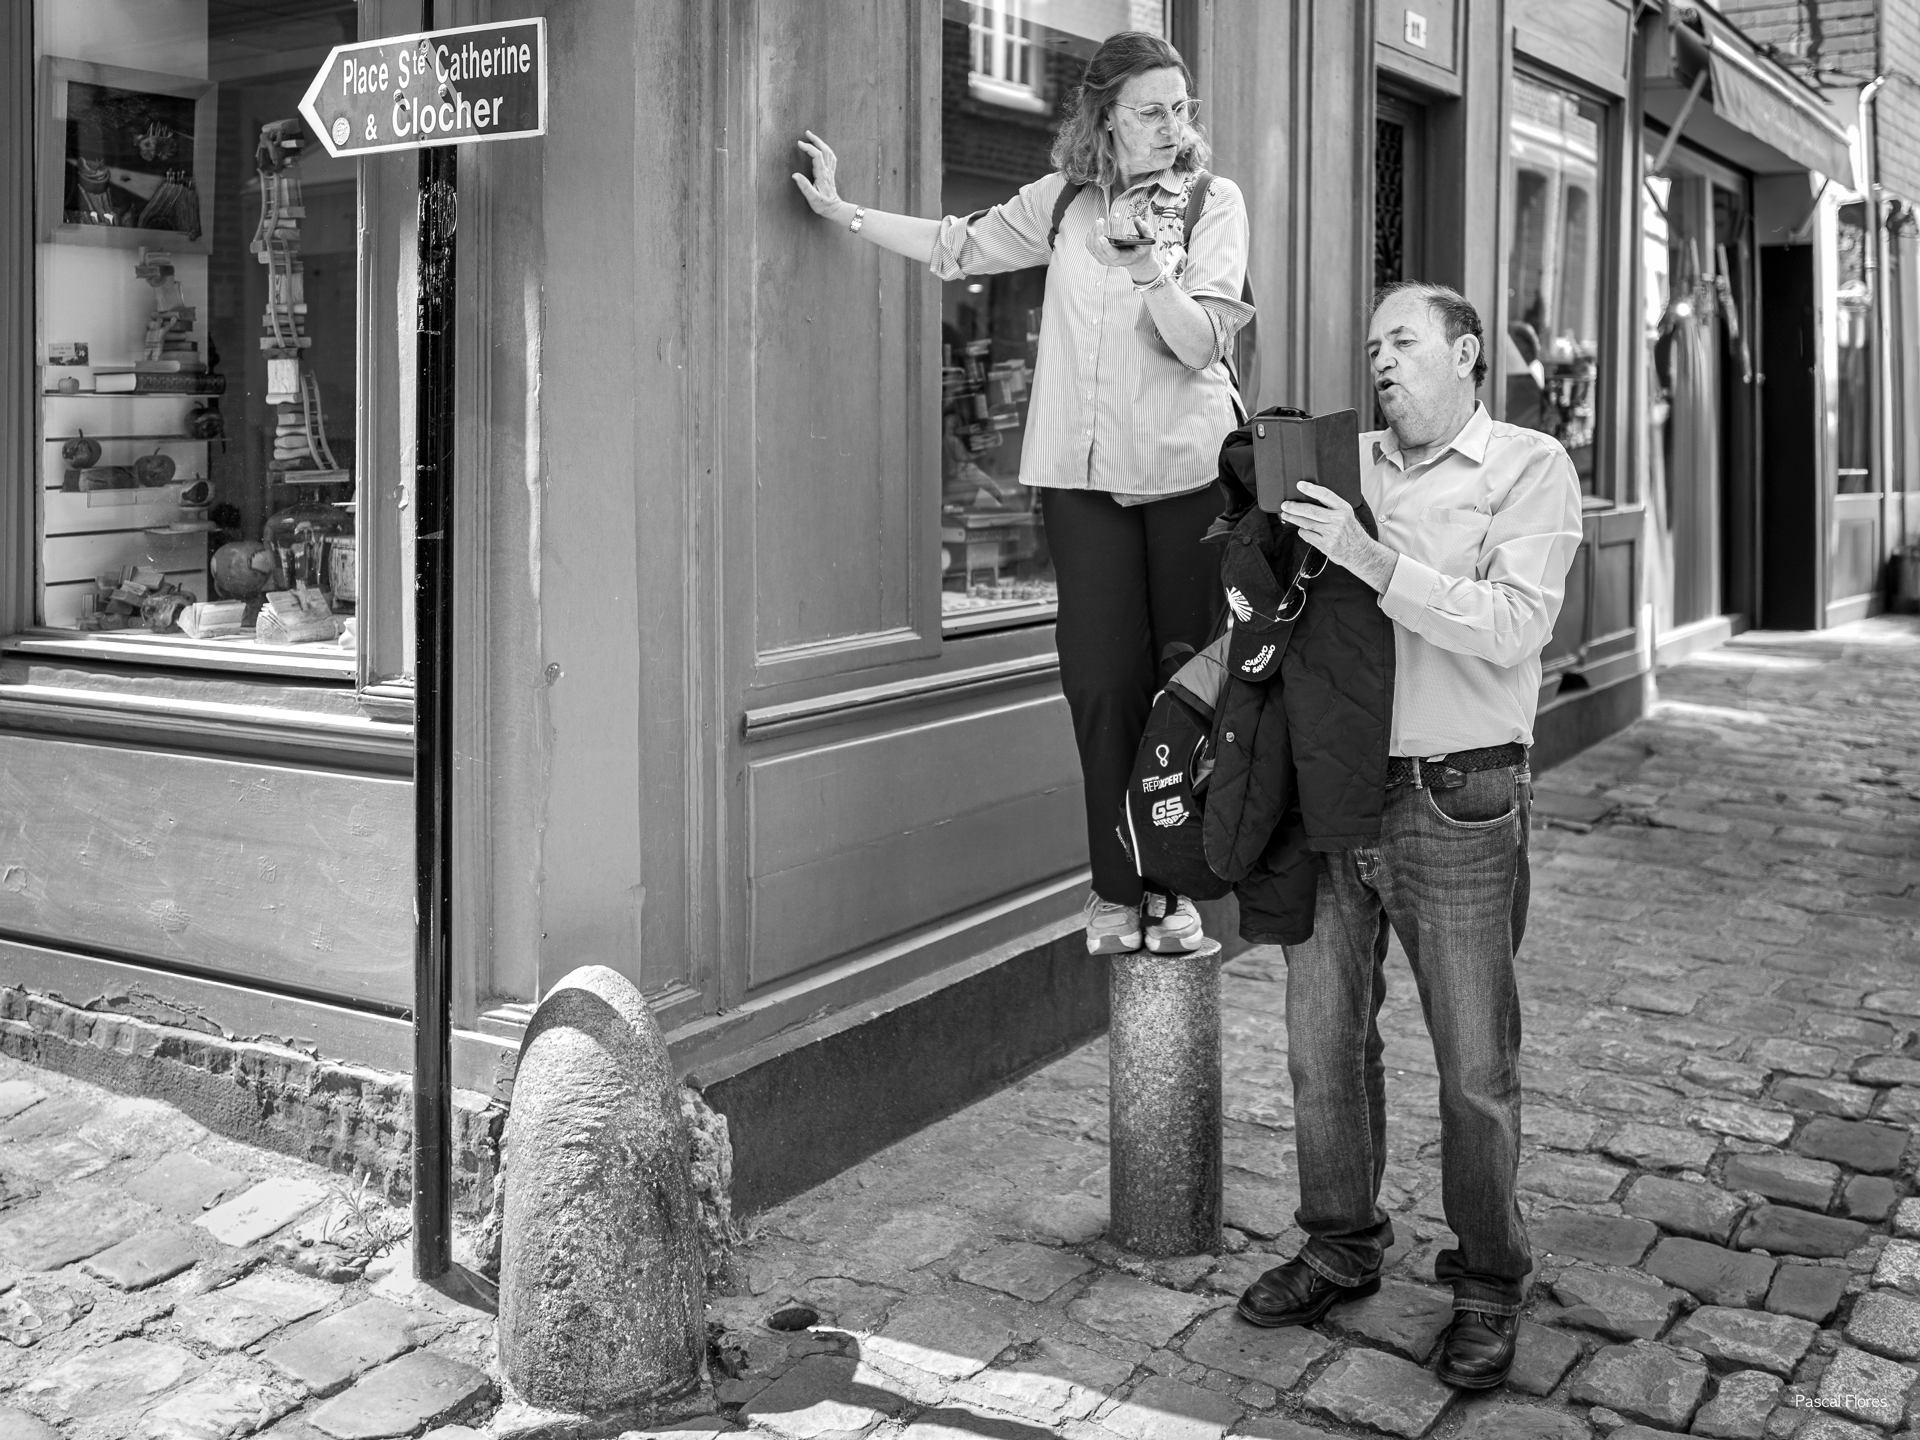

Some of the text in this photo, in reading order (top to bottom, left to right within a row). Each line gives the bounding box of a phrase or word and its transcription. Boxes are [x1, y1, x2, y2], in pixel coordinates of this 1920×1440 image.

[343, 59, 389, 96] Place
[435, 37, 531, 83] Catherine
[365, 92, 503, 141] & Clocher
[1152, 796, 1184, 820] GS
